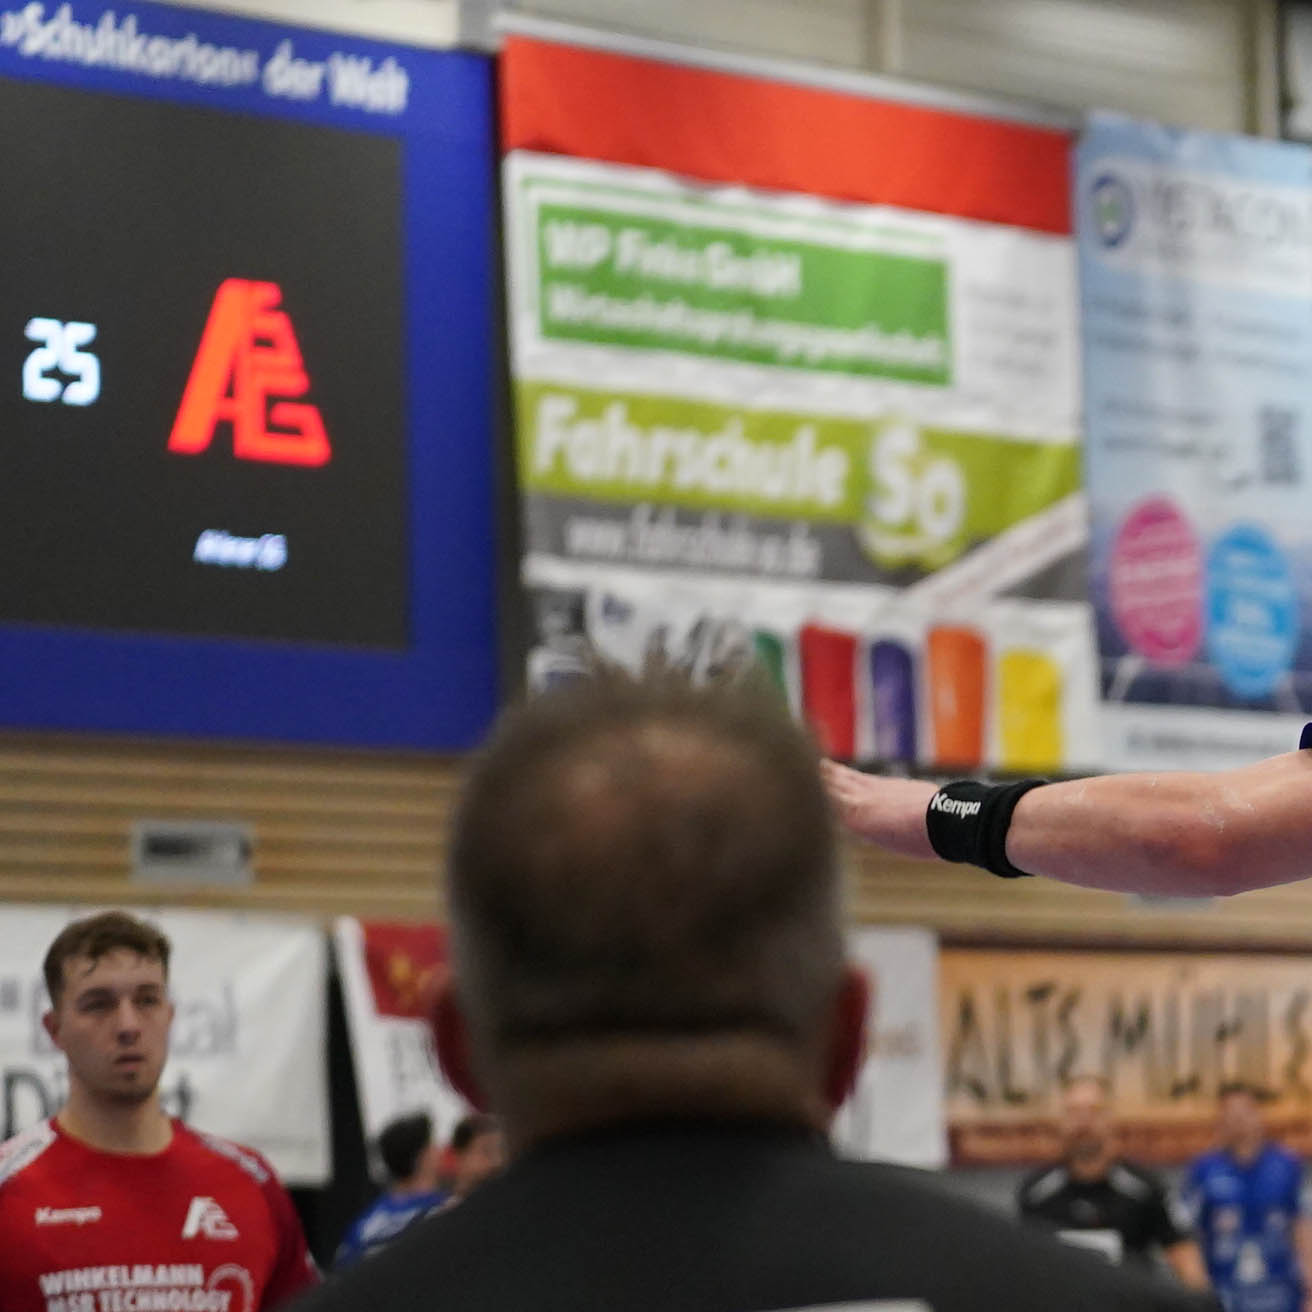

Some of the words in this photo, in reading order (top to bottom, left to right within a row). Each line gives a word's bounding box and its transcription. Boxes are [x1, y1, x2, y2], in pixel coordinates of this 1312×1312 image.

[23, 317, 101, 406] 25
[532, 392, 850, 508] Fahrschule
[930, 792, 982, 820] Kempa
